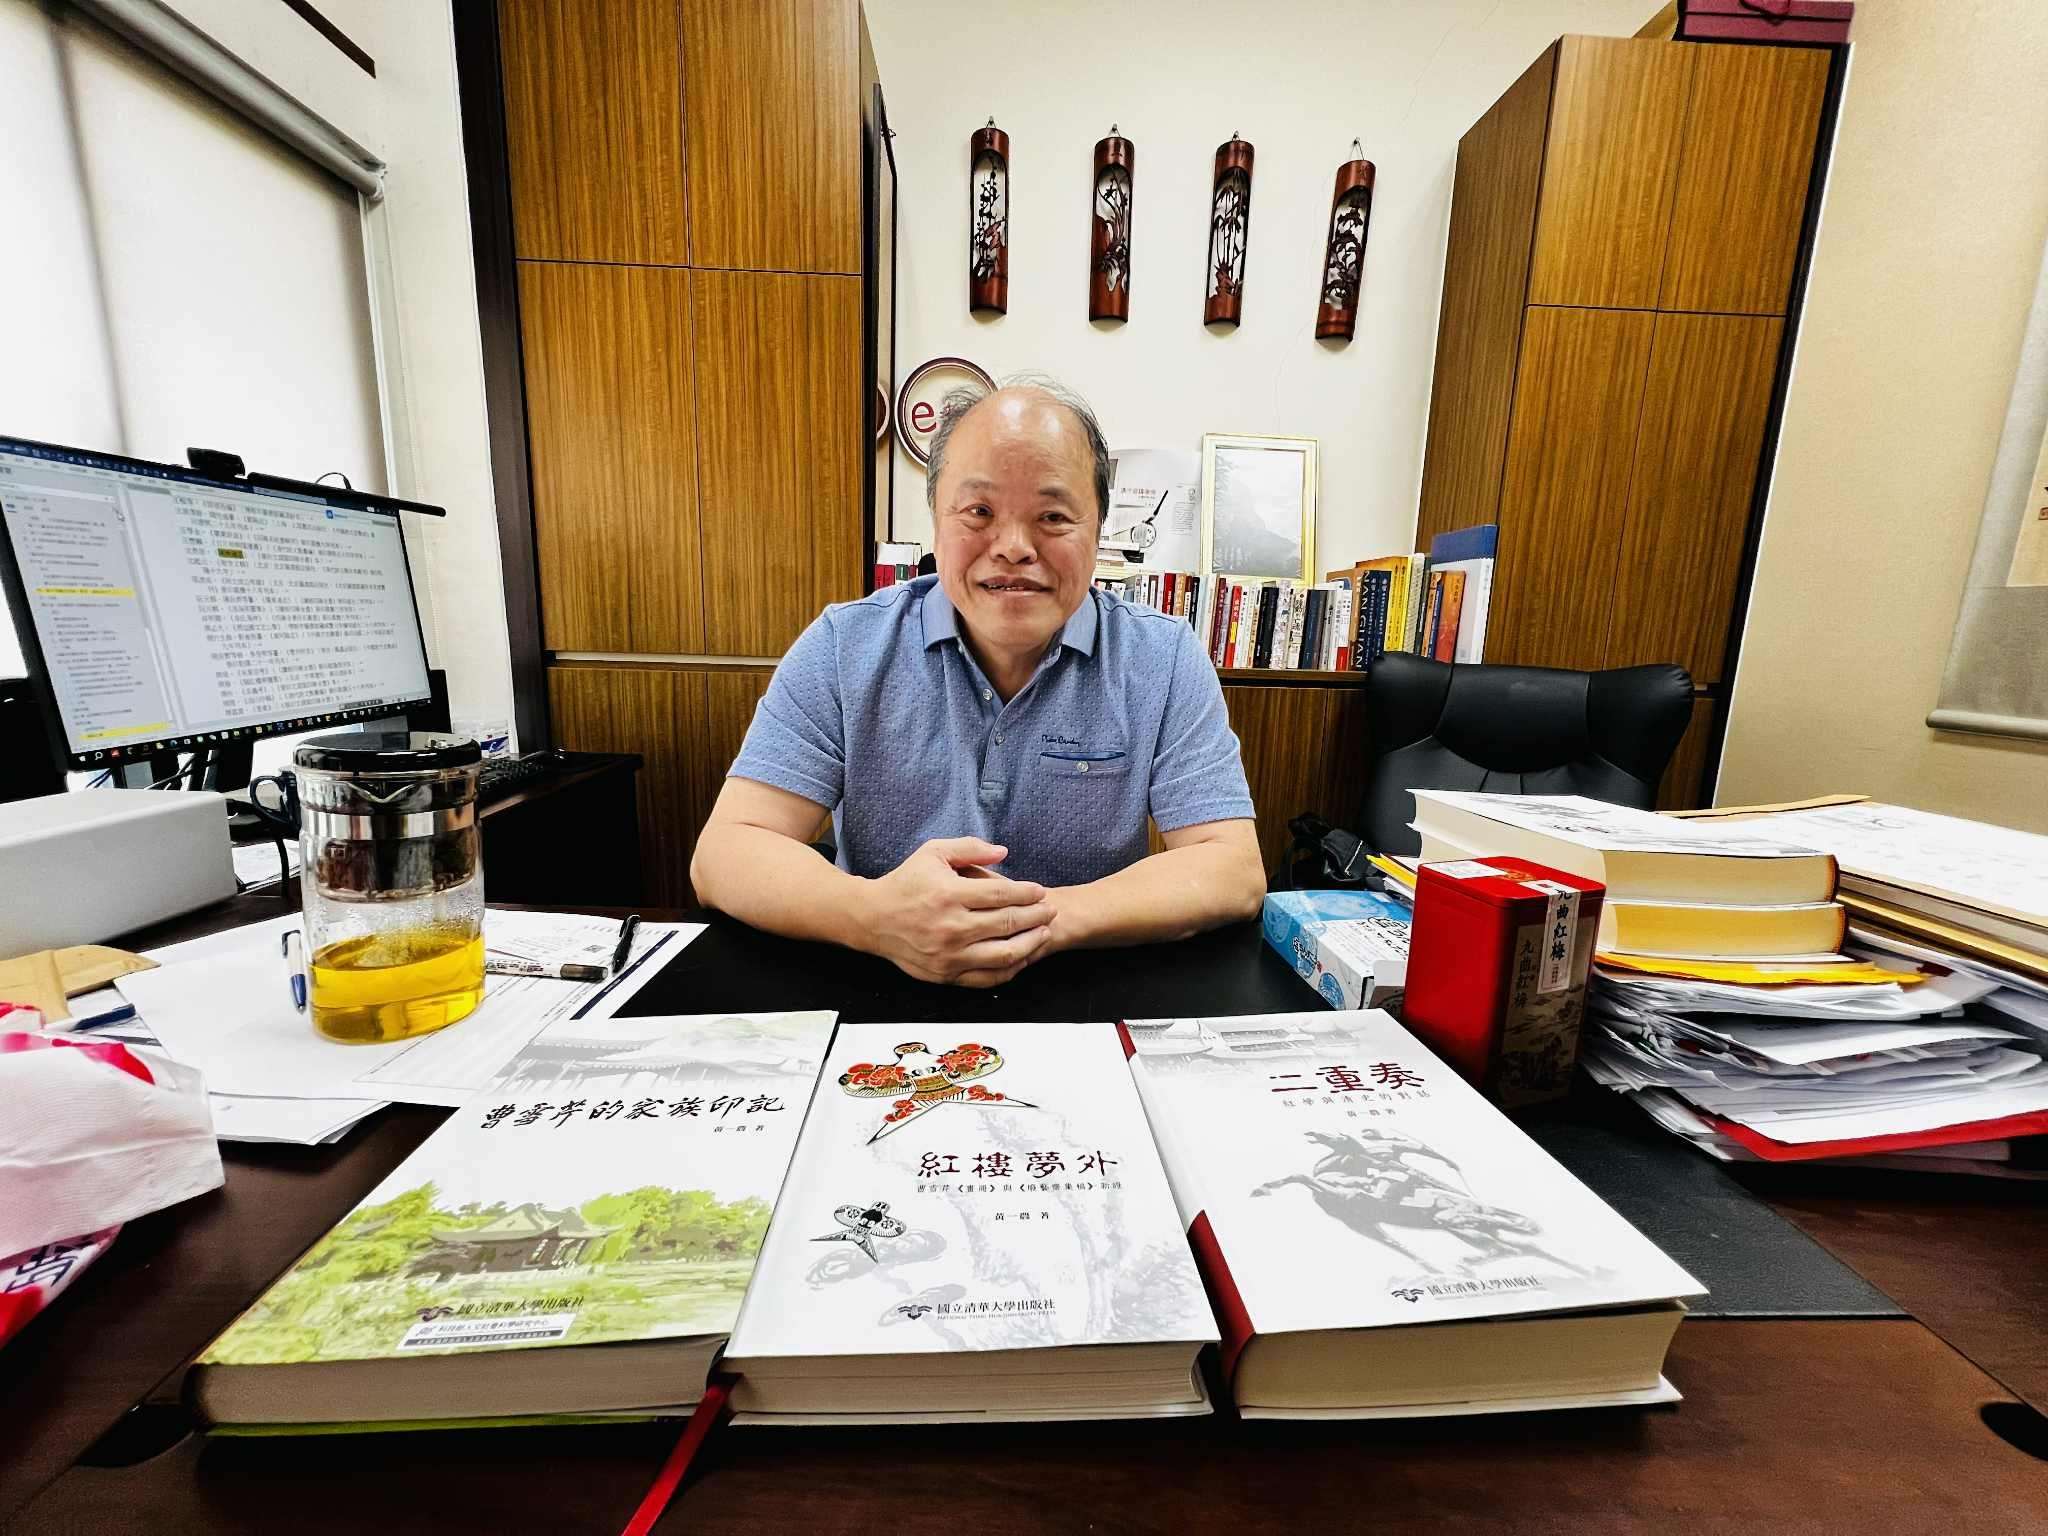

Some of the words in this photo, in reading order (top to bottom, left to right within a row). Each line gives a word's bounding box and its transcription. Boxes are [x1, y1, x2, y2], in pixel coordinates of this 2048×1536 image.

[1550, 889, 1572, 962] 九曲紅梅
[1269, 1062, 1425, 1094] 二重奏
[480, 1095, 786, 1128] 曹雪芹的家族印記
[917, 1151, 1118, 1179] 紅樓夢外
[937, 1299, 1056, 1315] 國立清華大學出版社
